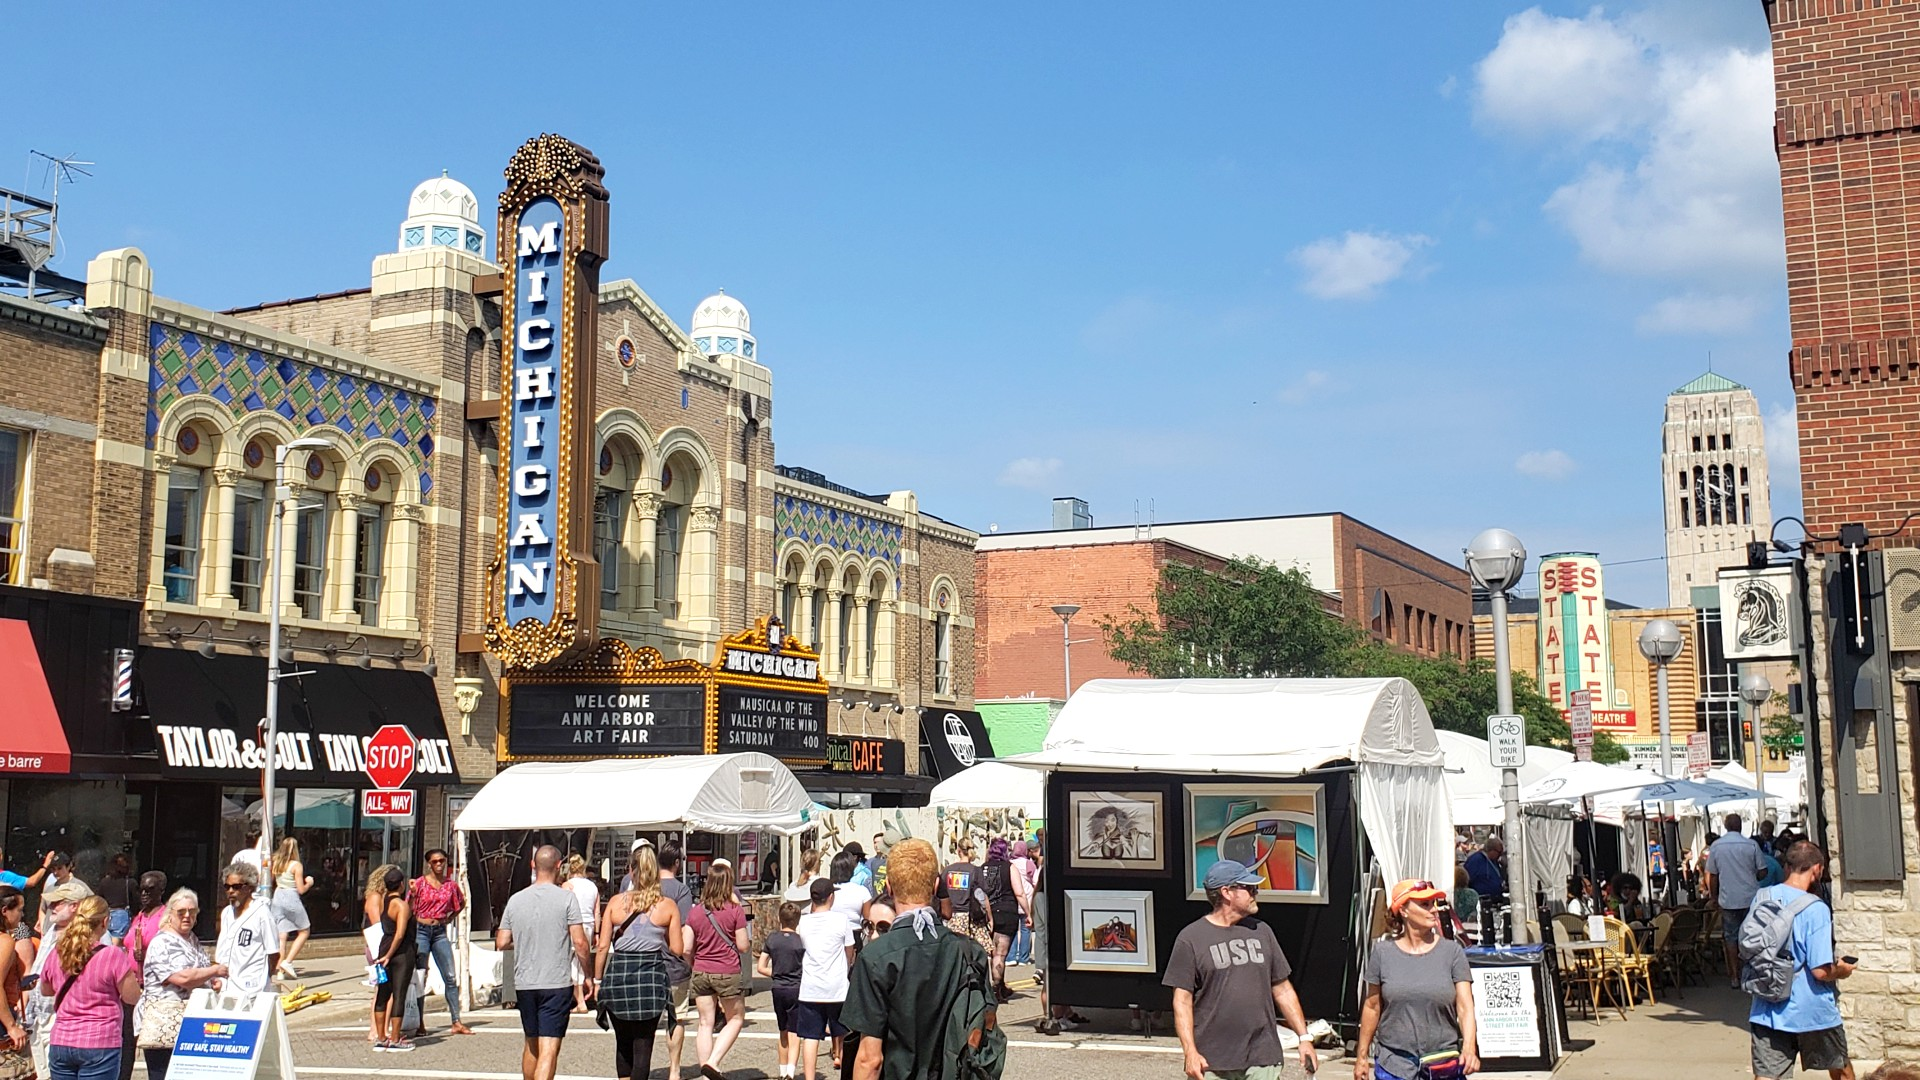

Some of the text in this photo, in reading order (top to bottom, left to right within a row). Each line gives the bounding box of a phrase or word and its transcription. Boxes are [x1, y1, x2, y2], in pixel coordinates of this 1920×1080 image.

[510, 221, 560, 596] MICHIGAN
[1544, 568, 1562, 703] STATE
[1580, 567, 1603, 702] STATE
[727, 650, 819, 680] MICHIGAN
[575, 694, 651, 708] WELCOME
[740, 697, 813, 716] NAUSICAA OF THE
[561, 711, 655, 726] ANN ARBOR
[731, 713, 818, 732] VALLEY OF THE WIND
[1592, 713, 1627, 724] HEATRE
[572, 729, 649, 743] ART FAIR
[729, 730, 819, 749] SATURDAY 400
[1499, 738, 1517, 746] WALK
[368, 745, 412, 769] STOP
[826, 739, 884, 772] pical CAFE
[1499, 747, 1518, 755] YOUR
[8, 754, 42, 768] barre
[1209, 938, 1265, 970] USC
[179, 1042, 250, 1054] STAY SAFE, STAY HEALTHY
